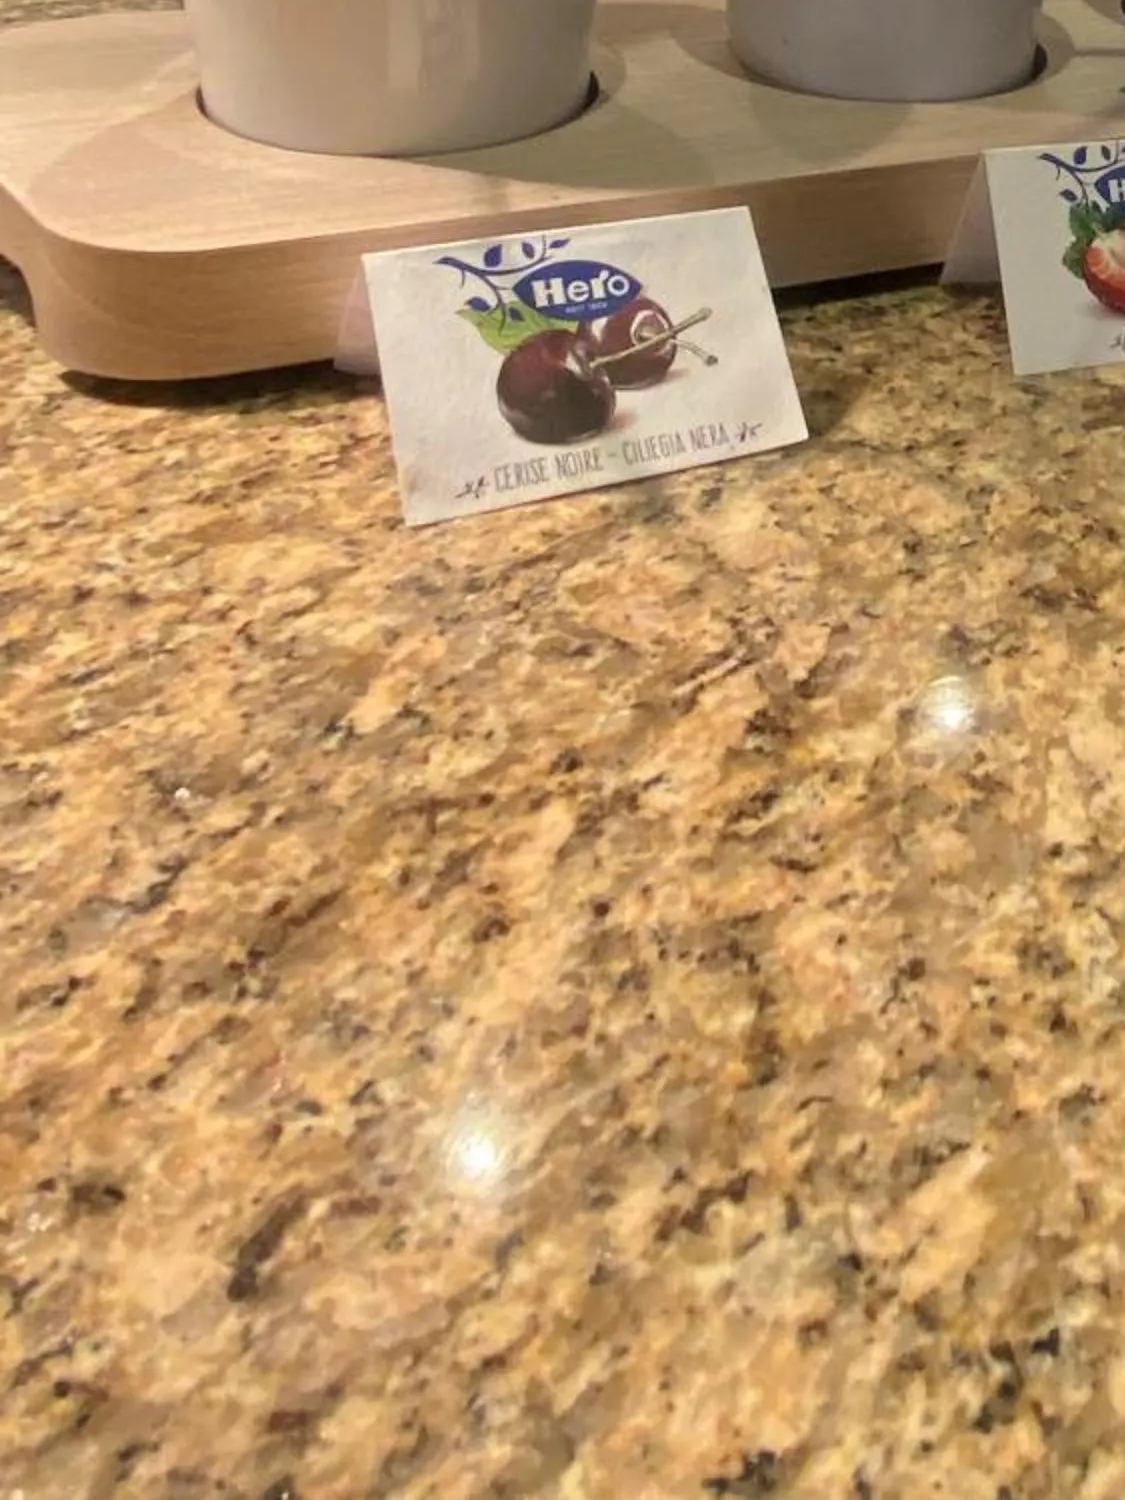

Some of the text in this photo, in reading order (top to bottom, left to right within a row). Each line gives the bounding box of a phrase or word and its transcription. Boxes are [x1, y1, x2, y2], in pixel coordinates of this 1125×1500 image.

[530, 269, 630, 308] Hero
[493, 456, 550, 493] CERISE
[555, 447, 604, 481] NOIRE
[690, 422, 731, 451] NERA
